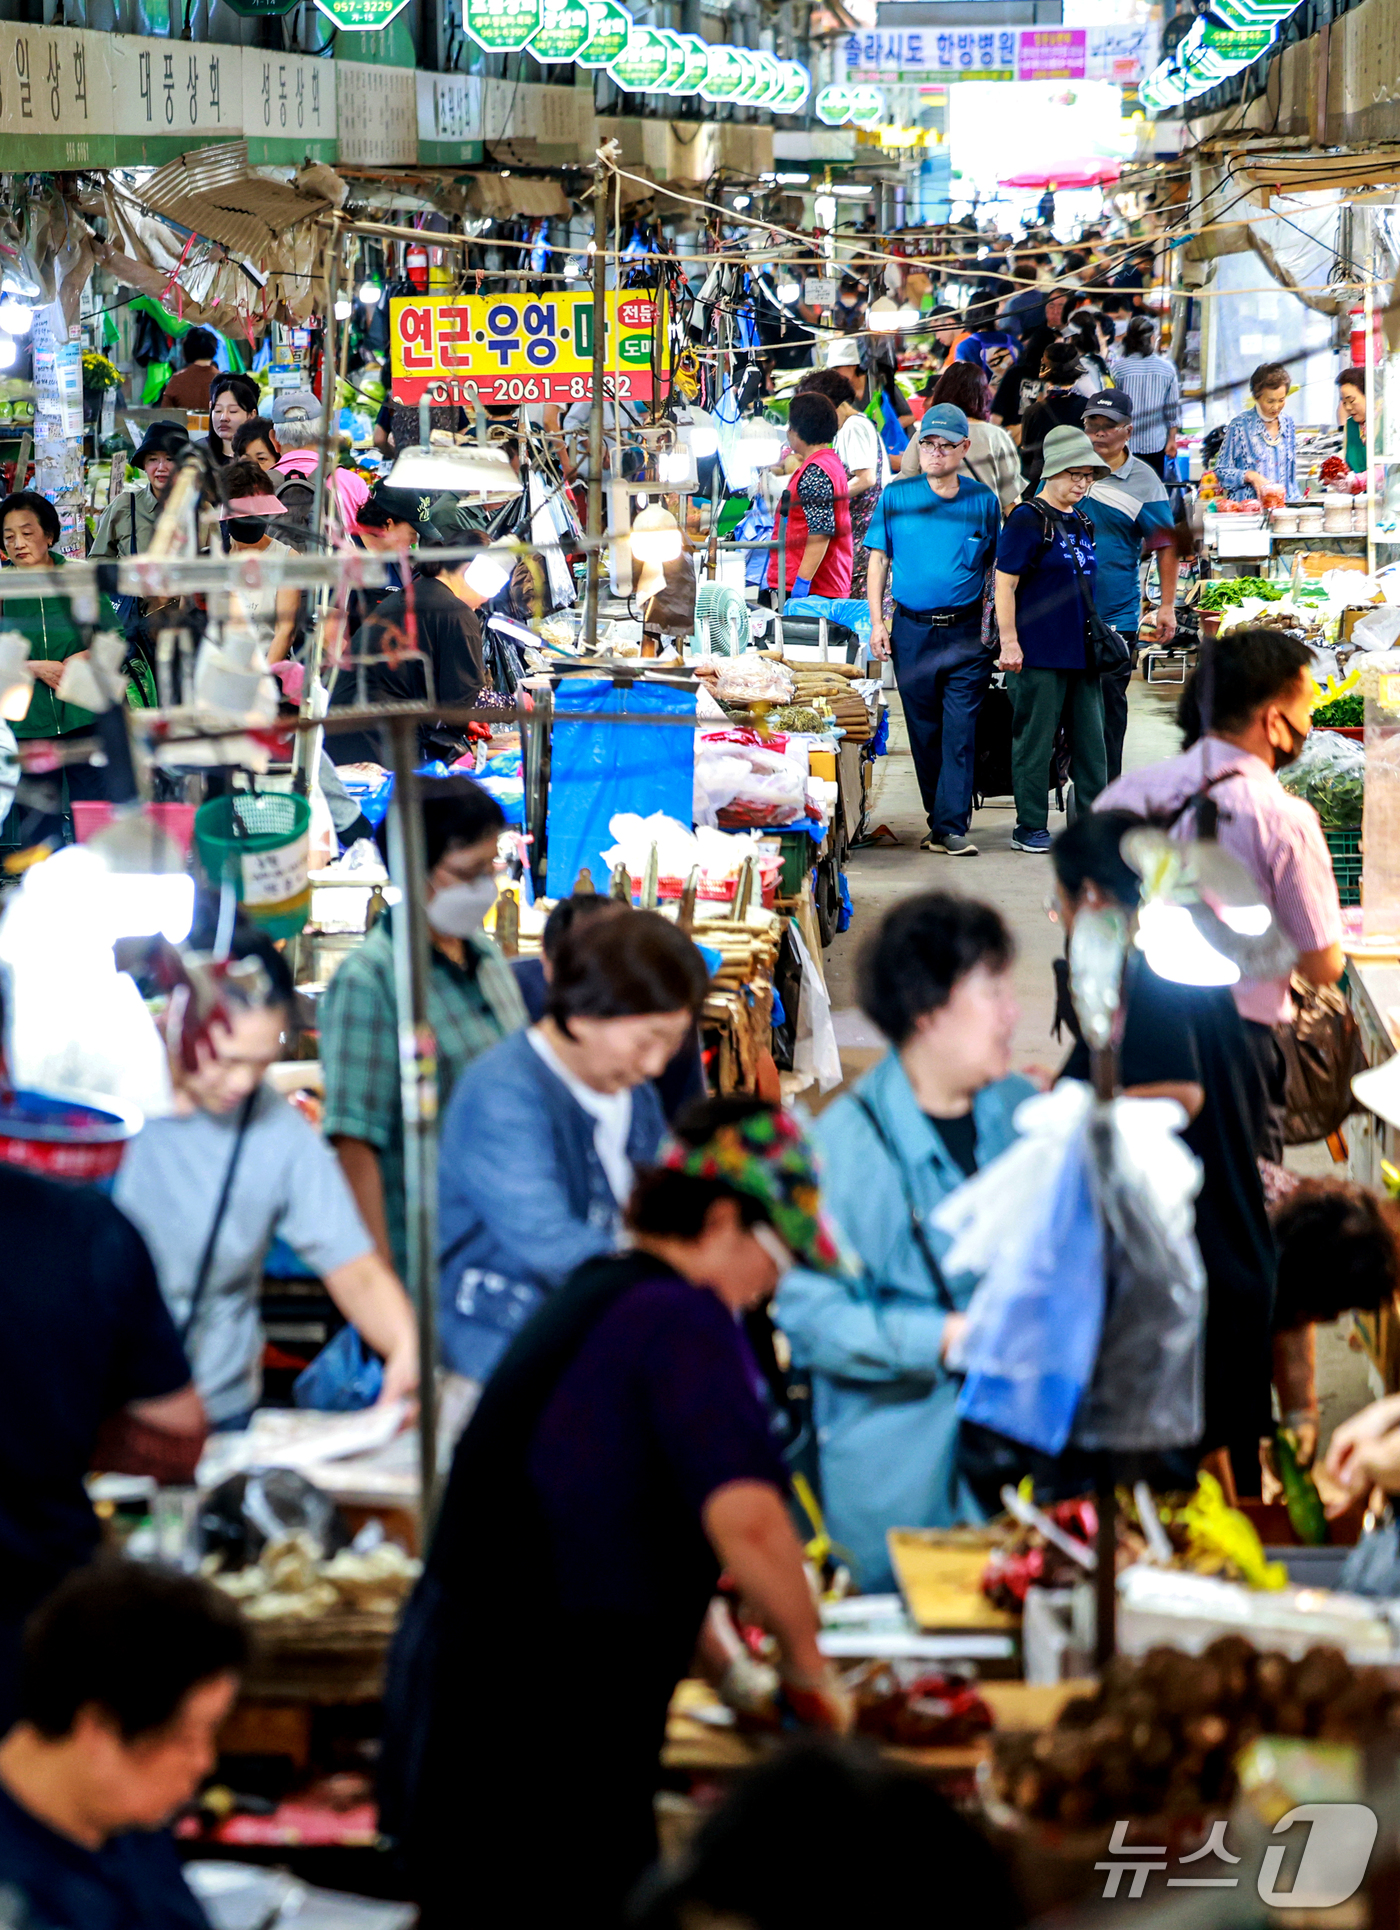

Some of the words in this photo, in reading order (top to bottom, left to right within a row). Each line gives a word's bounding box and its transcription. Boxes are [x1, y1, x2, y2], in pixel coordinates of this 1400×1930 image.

[333, 1, 393, 13] 957-3229
[351, 13, 375, 22] 가-15
[844, 33, 924, 66] 솔라시도
[937, 32, 1015, 66] 한방병원
[0, 38, 87, 120] 일상회
[140, 51, 220, 124] 대풍상회
[262, 63, 321, 127] 성동상회
[432, 376, 632, 402] 010-2061-8582
